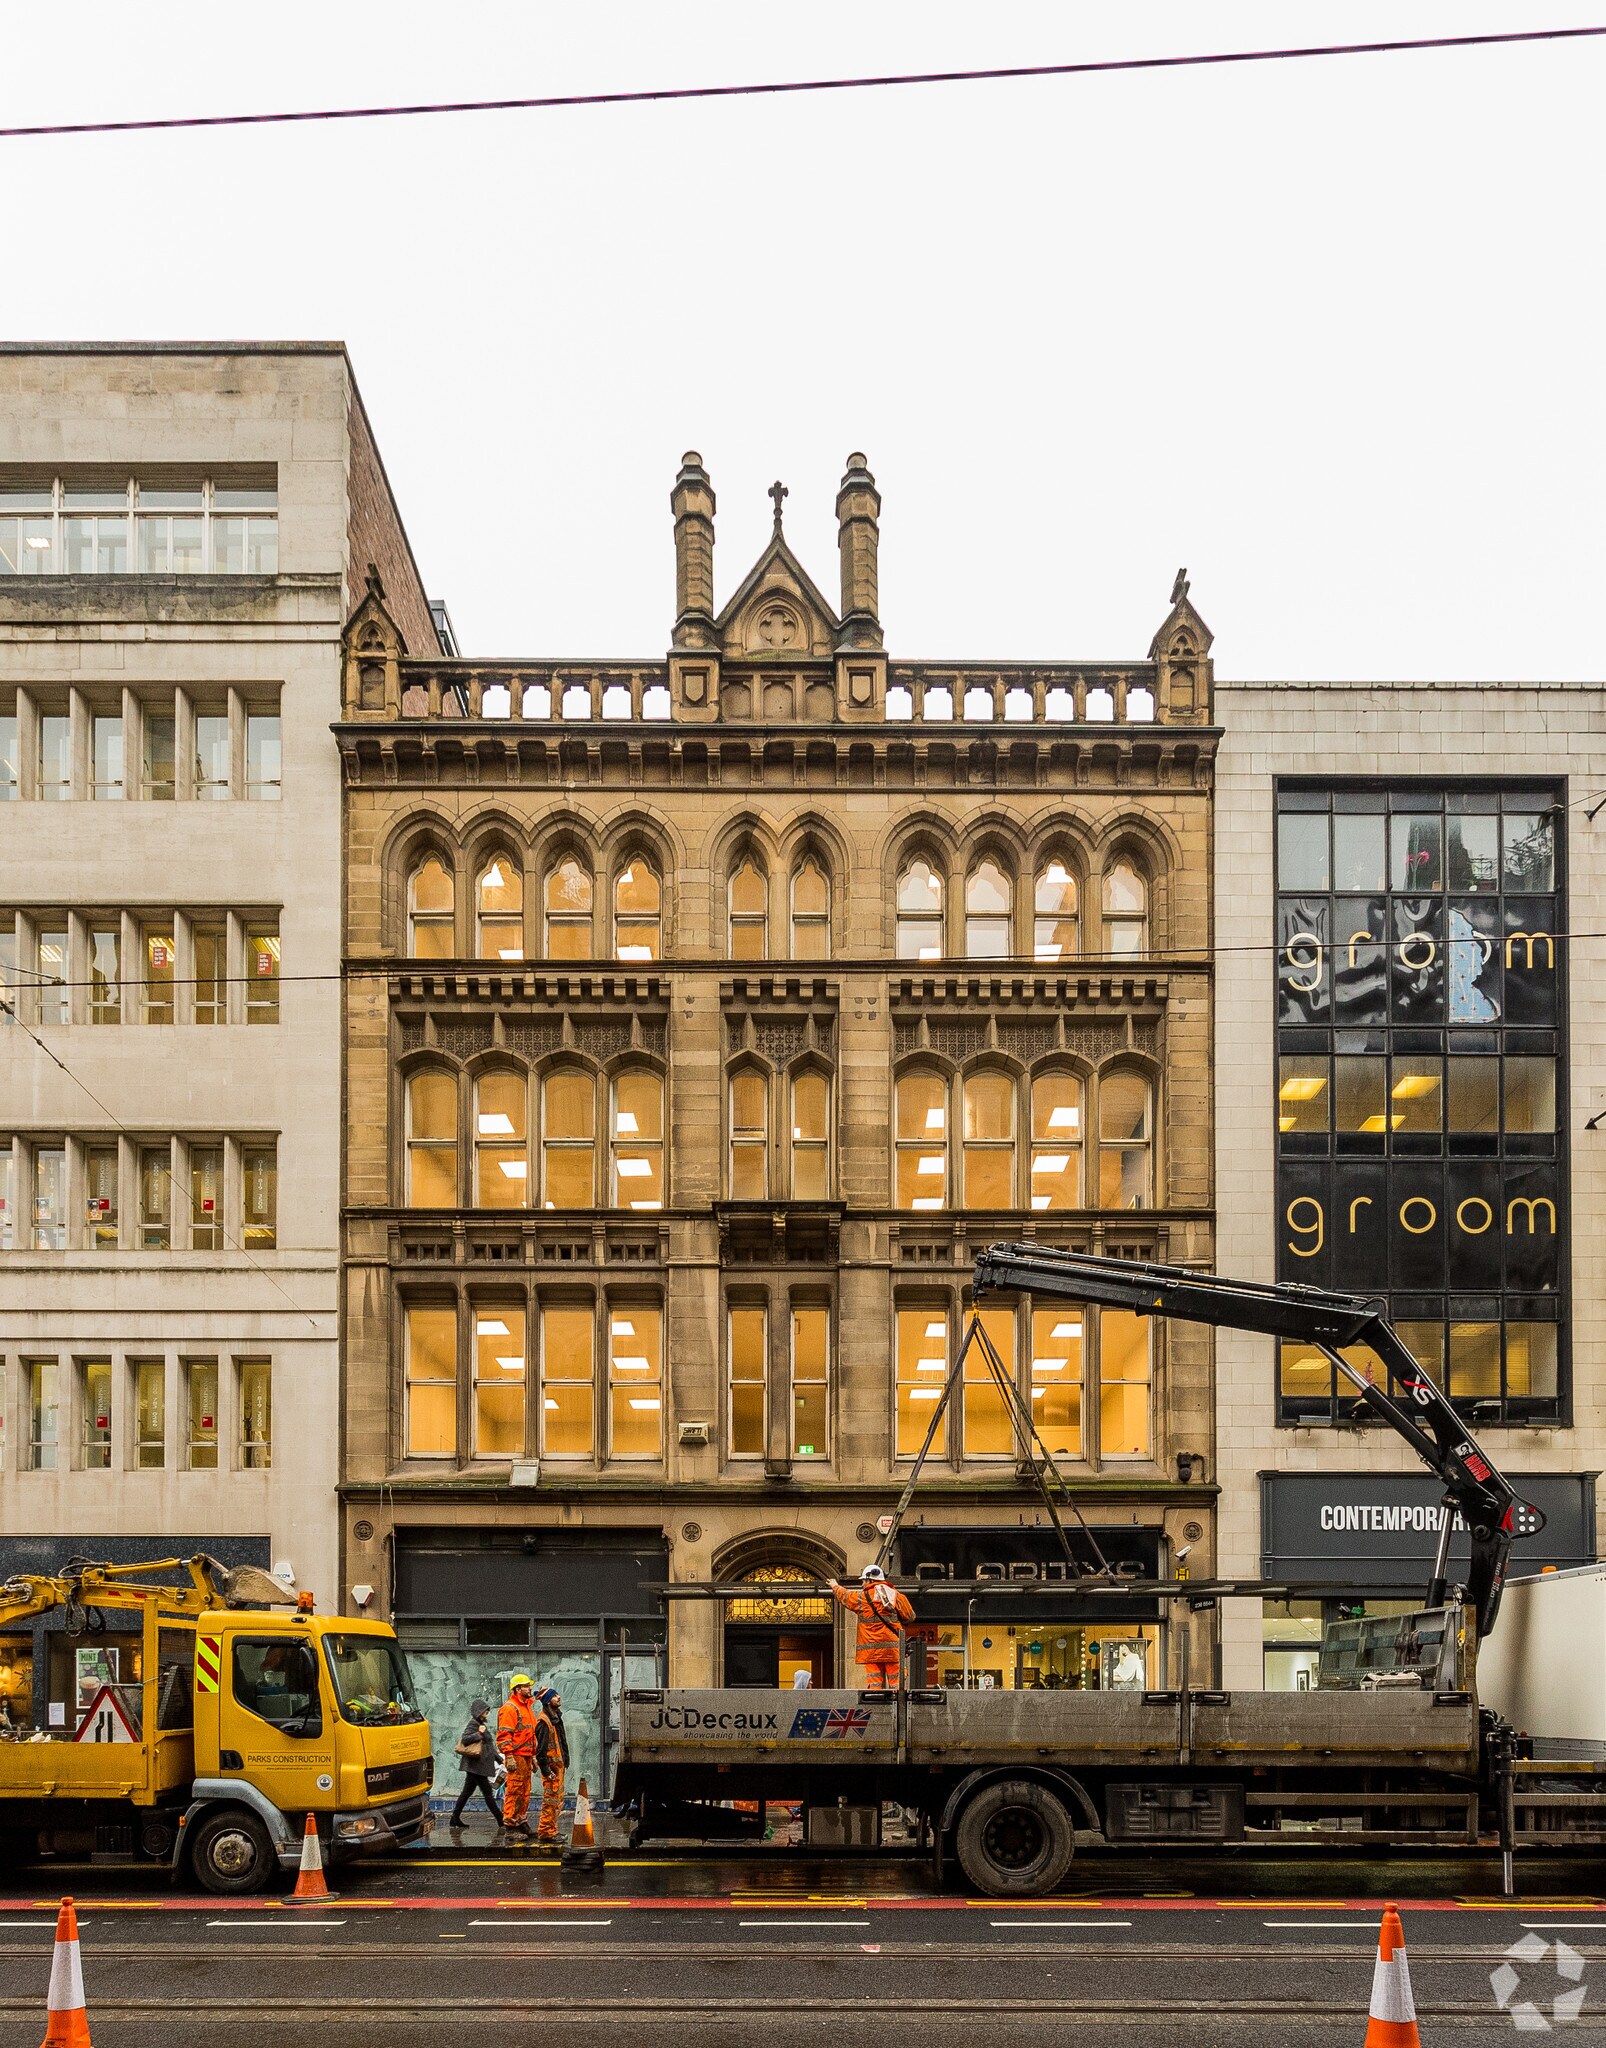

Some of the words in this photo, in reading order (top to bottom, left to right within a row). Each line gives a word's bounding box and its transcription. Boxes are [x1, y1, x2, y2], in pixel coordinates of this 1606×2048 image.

[1287, 1197, 1556, 1257] groom
[80, 1653, 97, 1661] MINT
[650, 1706, 778, 1729] JCDecaux
[683, 1730, 734, 1740] showcasing
[737, 1730, 751, 1739] the
[754, 1730, 779, 1739] world
[248, 1755, 272, 1763] PARKS
[273, 1755, 331, 1763] CONSTRUCTION
[367, 1771, 390, 1783] DAF
